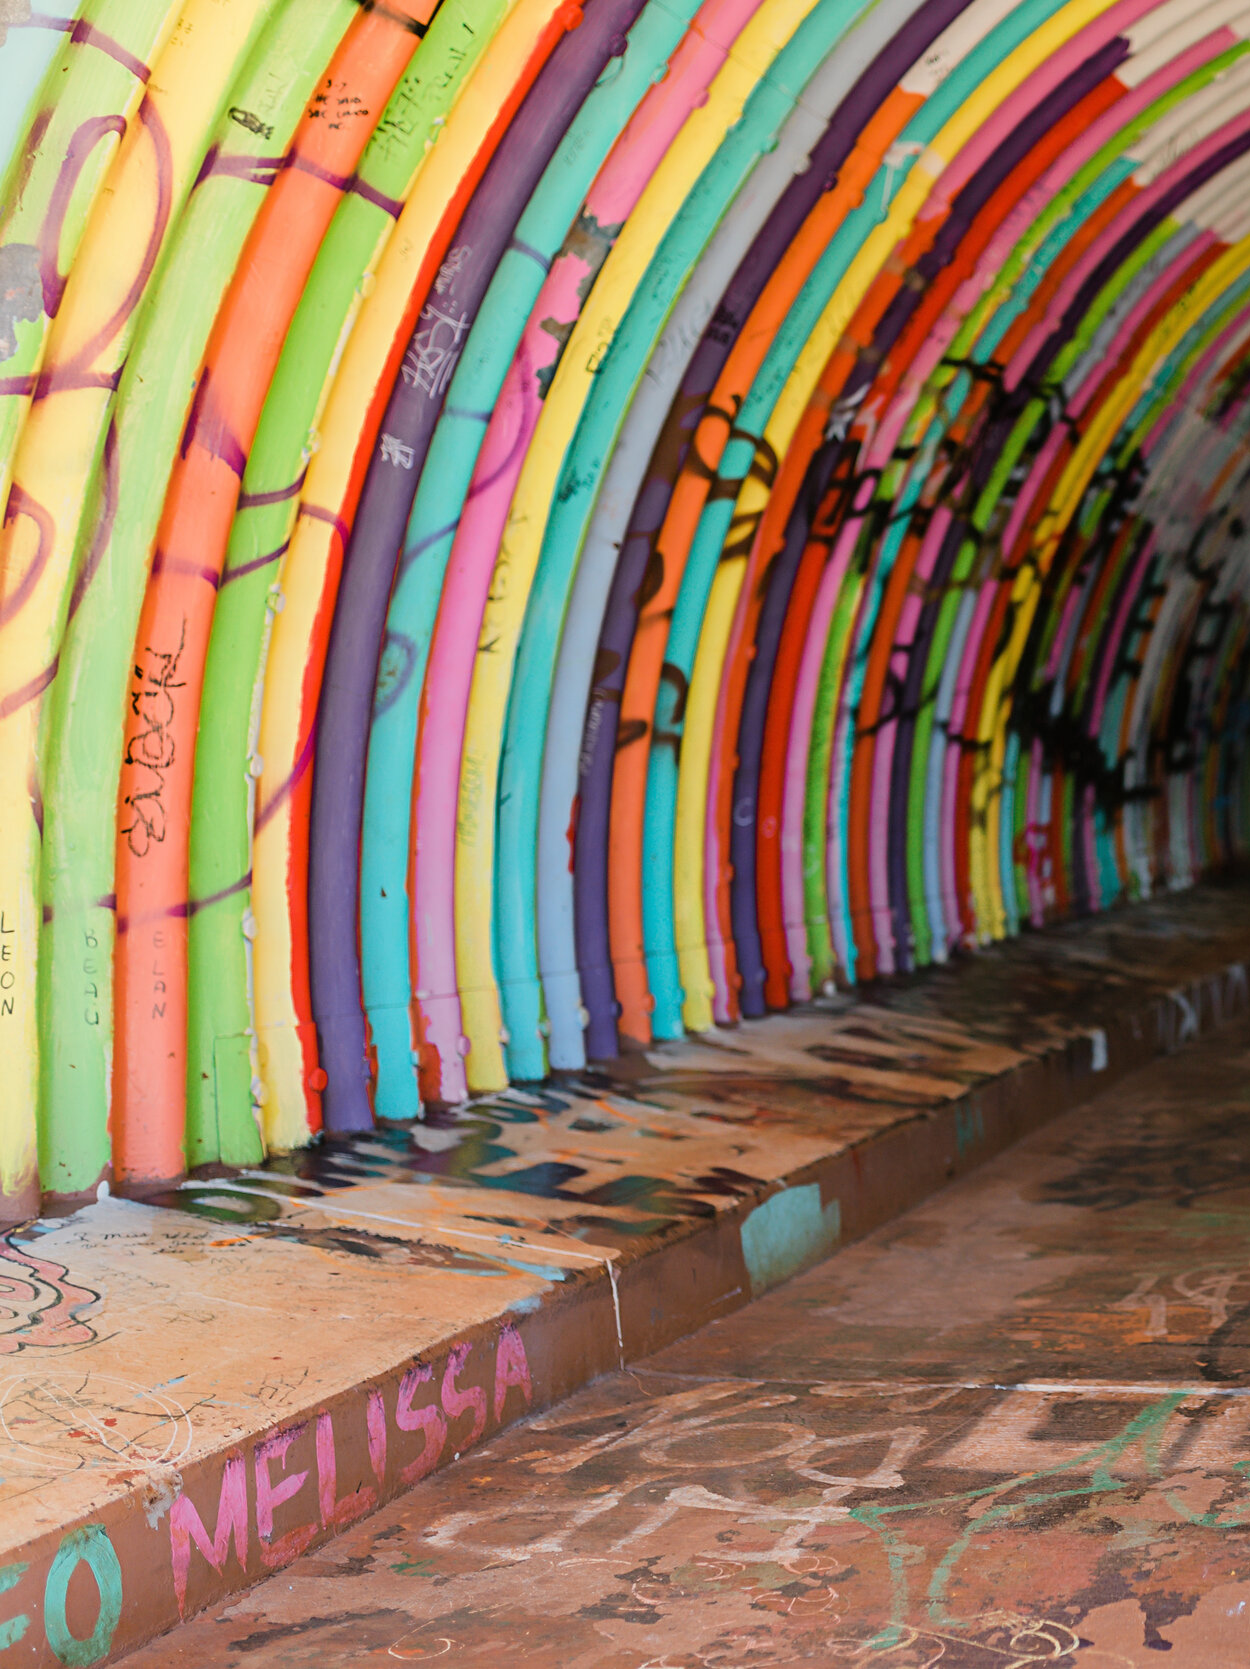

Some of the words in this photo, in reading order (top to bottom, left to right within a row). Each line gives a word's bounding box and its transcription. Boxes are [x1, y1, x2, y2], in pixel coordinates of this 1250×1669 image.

[0, 911, 15, 1016] LEON
[83, 928, 100, 1026] BEAU
[152, 931, 167, 1020] ELAN
[170, 1322, 533, 1622] MELISSA
